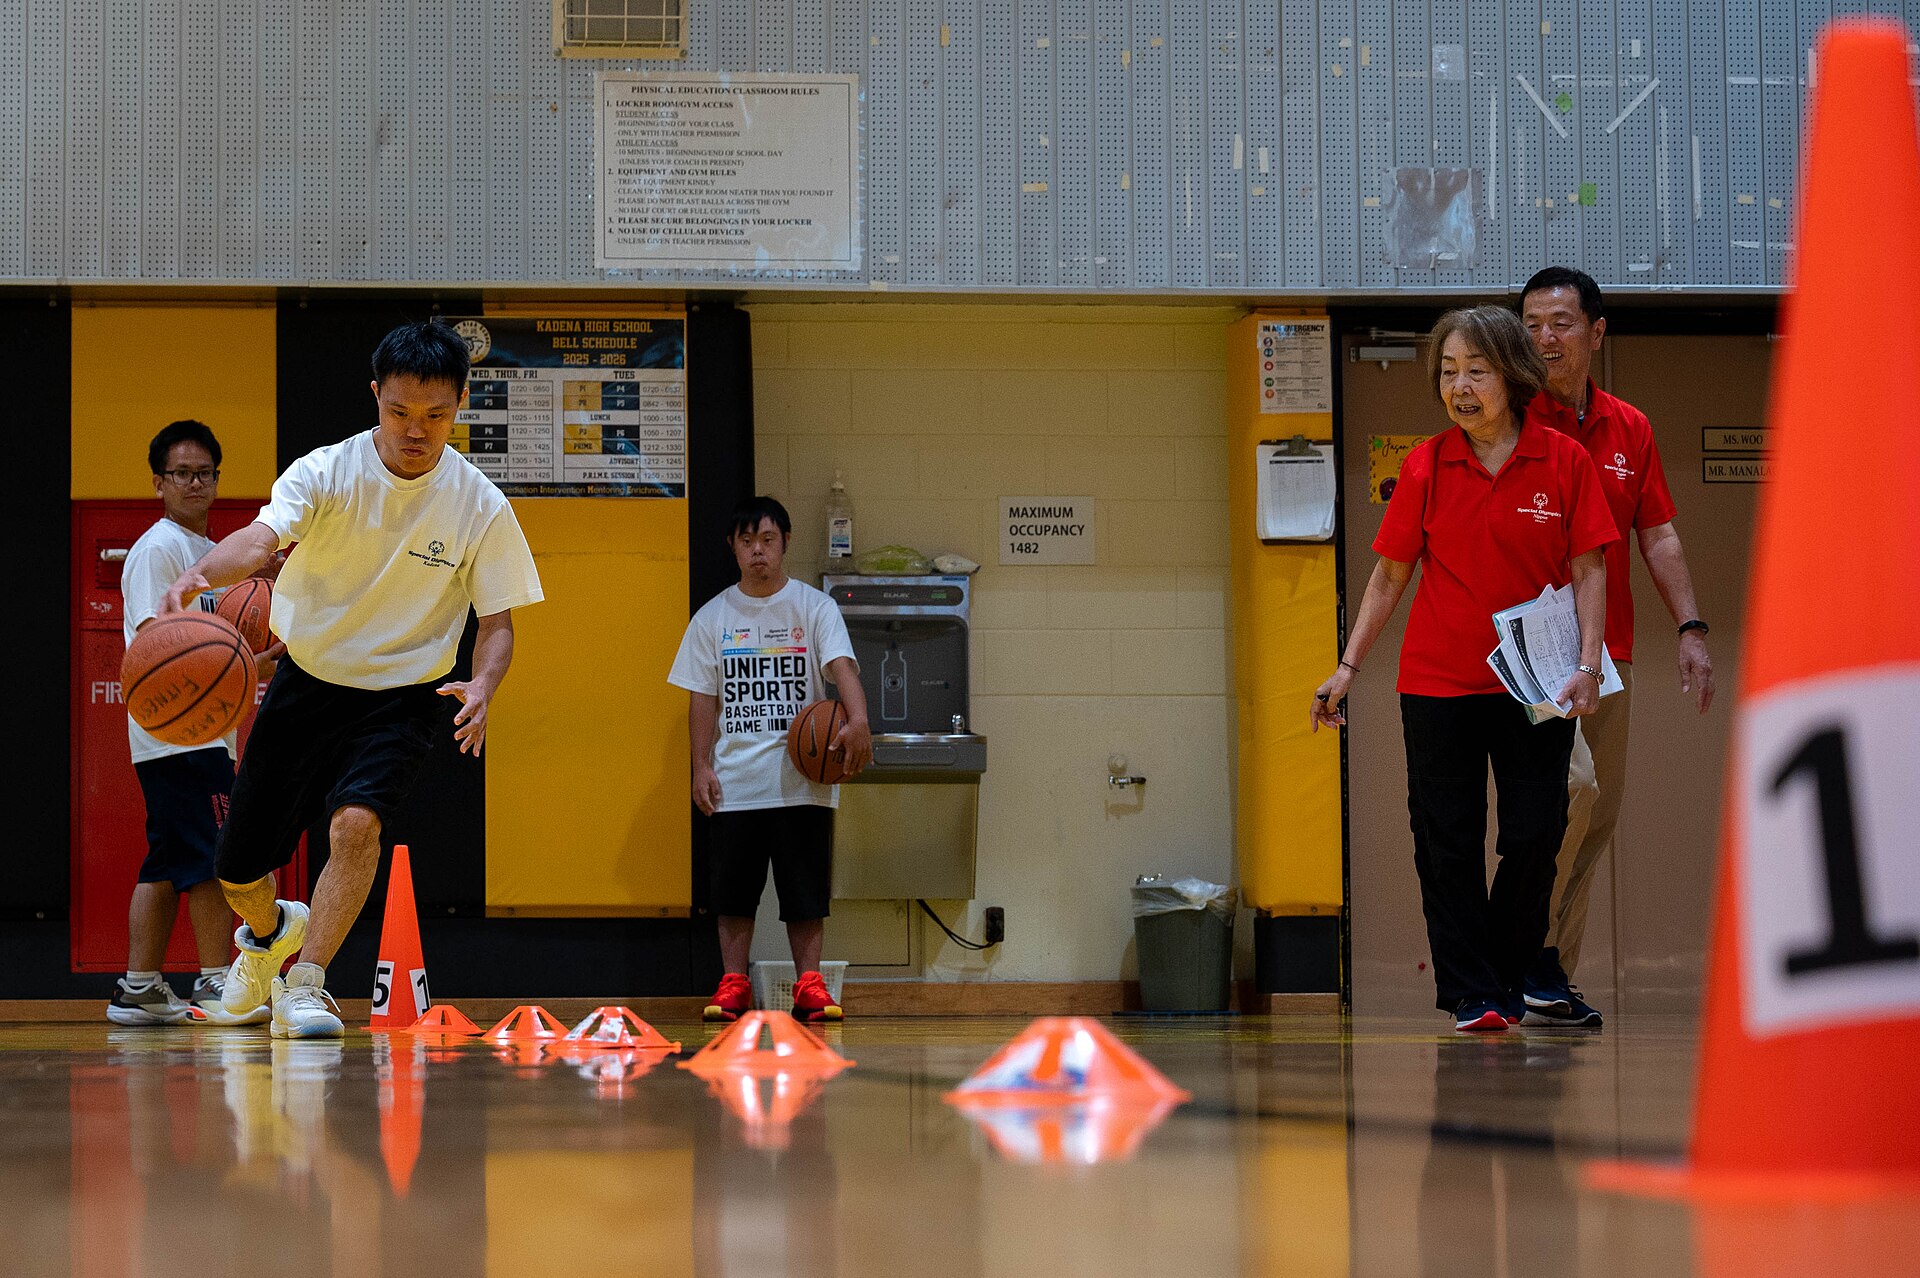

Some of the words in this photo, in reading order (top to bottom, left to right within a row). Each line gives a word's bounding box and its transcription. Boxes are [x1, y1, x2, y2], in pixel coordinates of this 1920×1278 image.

[537, 321, 581, 332] KADENA
[585, 321, 610, 332] HIGH
[613, 321, 653, 332] SCHOOL
[552, 337, 579, 348] BELL
[582, 338, 637, 349] SCHEDULE
[563, 354, 589, 364] 2025
[600, 354, 626, 365] 2026
[471, 370, 492, 379] WED,
[495, 370, 521, 379] THUR,
[524, 370, 538, 378] FRI
[613, 371, 635, 379] TUES
[1724, 435, 1739, 444] MS.
[1708, 466, 1726, 476] MR.
[1729, 466, 1774, 476] MANALA
[540, 486, 585, 494] Intervention
[1009, 507, 1073, 518] MAXIMUM
[1009, 524, 1084, 536] OCCUPANCY
[1010, 543, 1039, 553] 1482
[408, 550, 430, 560] Special
[724, 656, 806, 679] UNIFIED
[92, 681, 123, 704] FIR
[726, 704, 802, 718] BASKETBAL
[727, 720, 762, 733] GAME
[1766, 721, 1920, 976] 1
[372, 967, 390, 1008] 5
[417, 974, 430, 1016] 1
